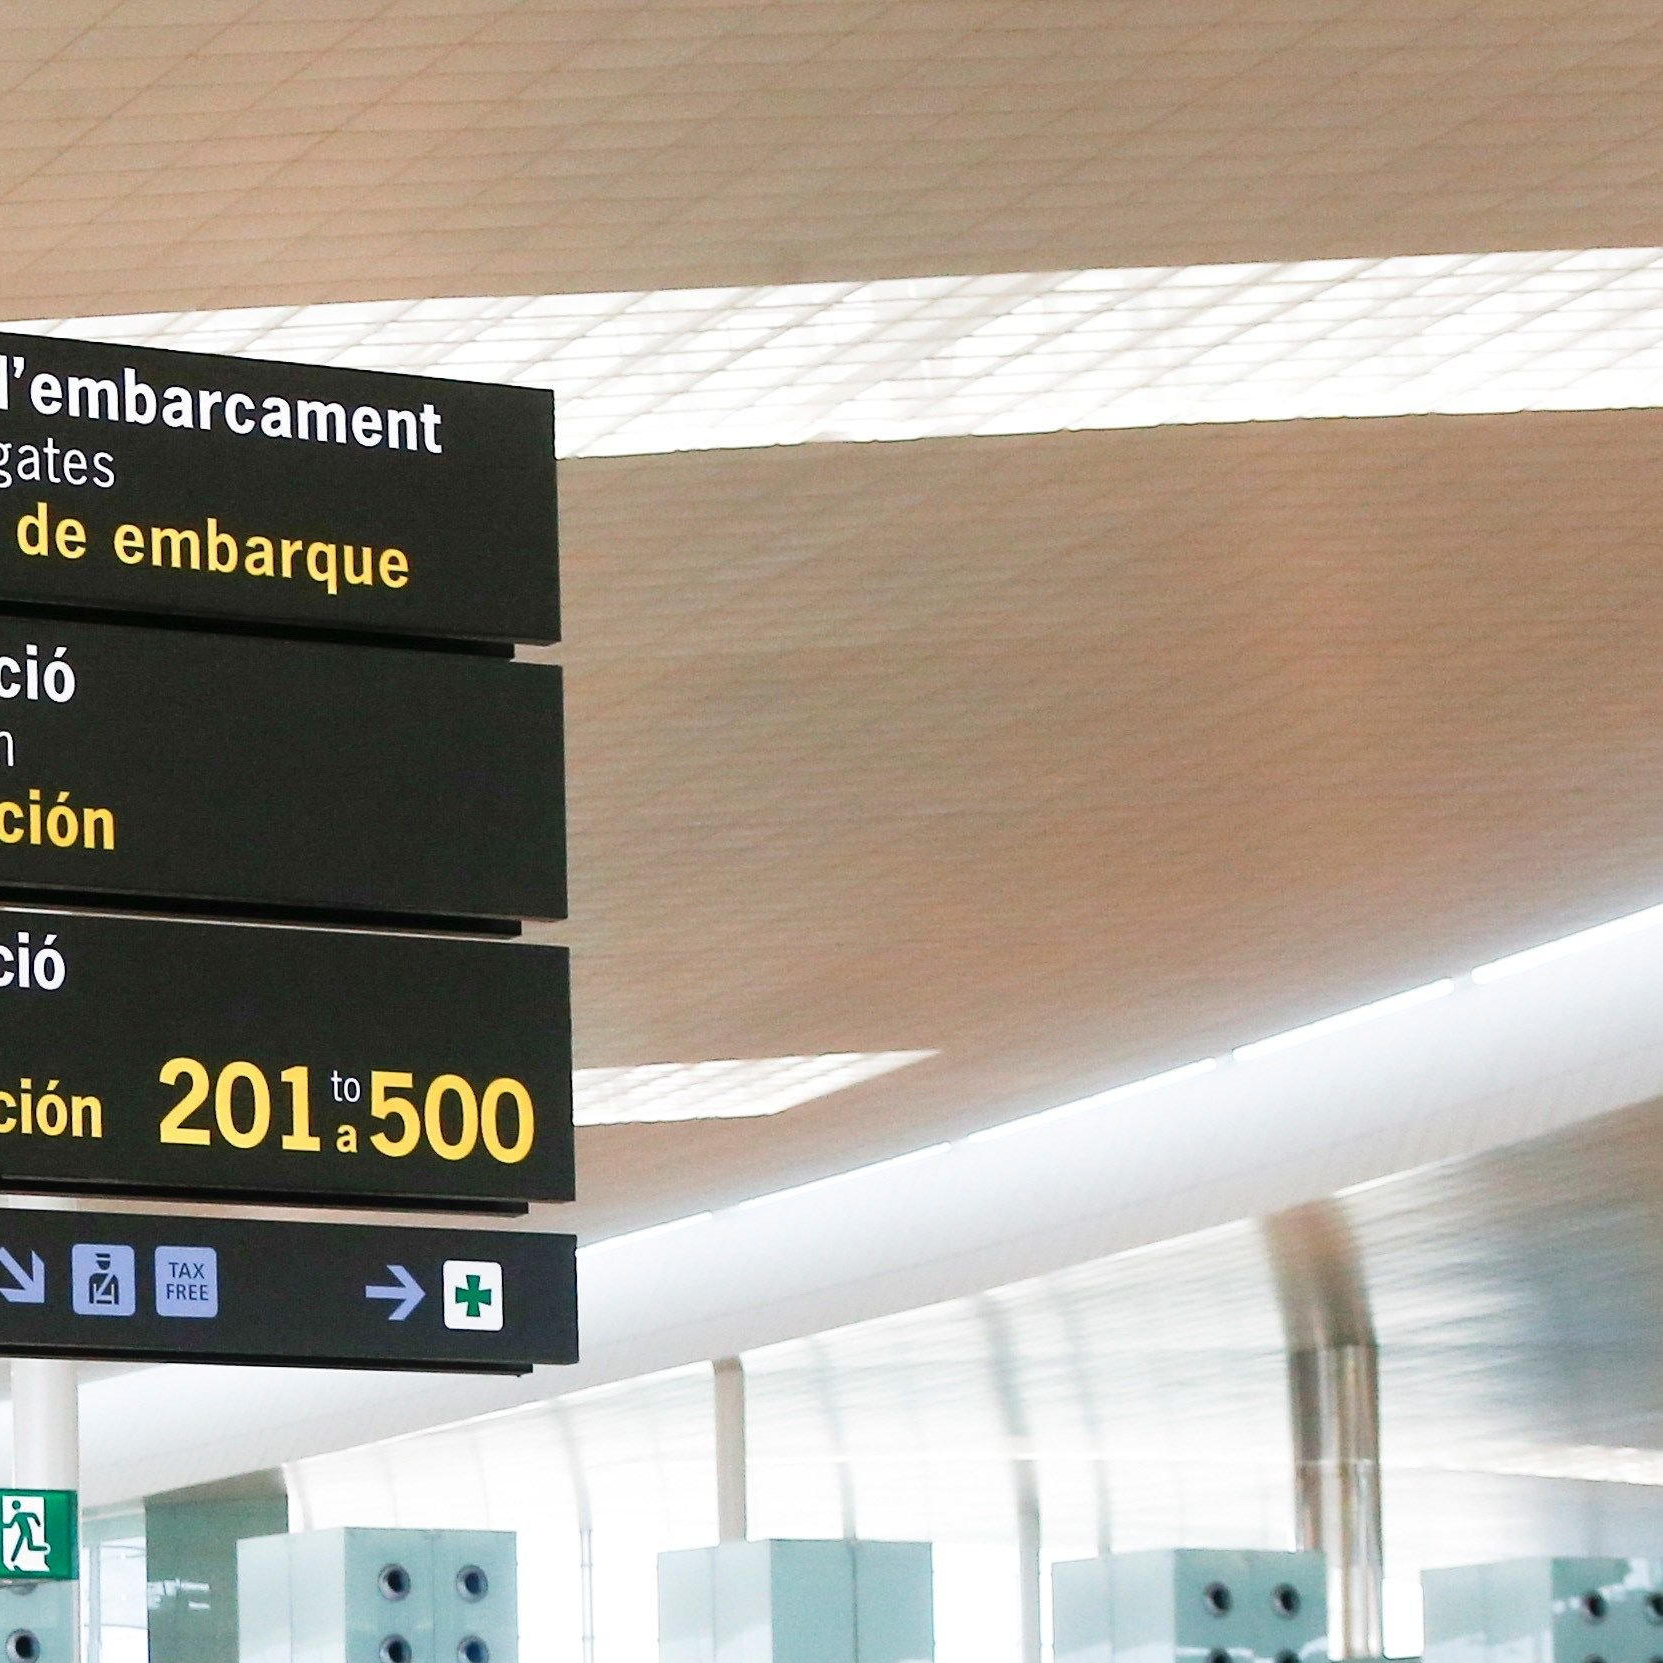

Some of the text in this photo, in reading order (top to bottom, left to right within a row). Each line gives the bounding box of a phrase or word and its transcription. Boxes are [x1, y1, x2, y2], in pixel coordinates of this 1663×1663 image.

[16, 501, 87, 559] de
[113, 517, 409, 595] embarque
[159, 1057, 535, 1164] 201 to a 500
[166, 1283, 209, 1301] FREE
[168, 1261, 205, 1280] TAX
